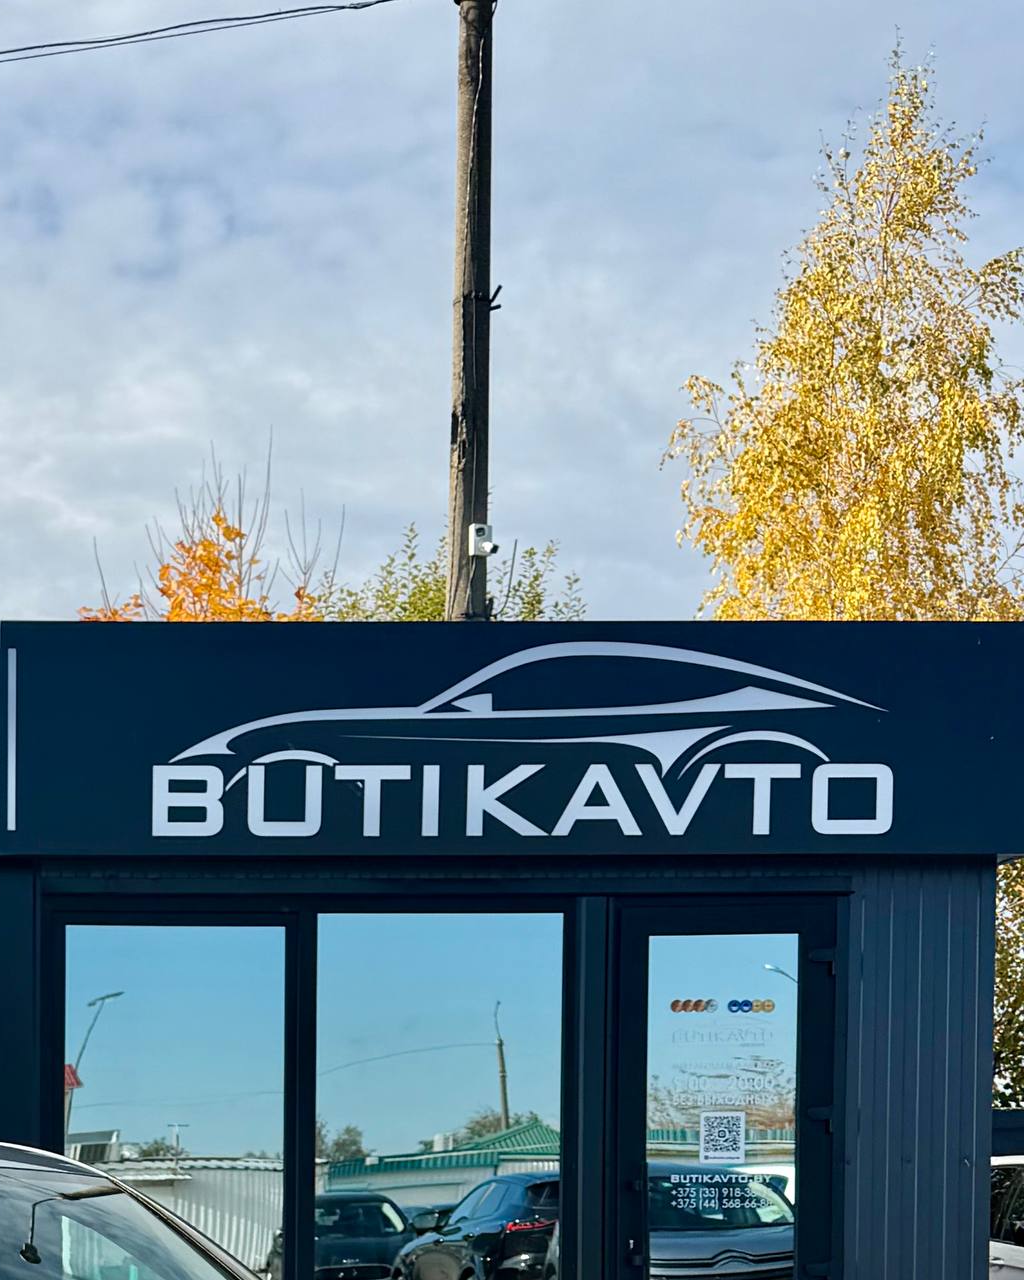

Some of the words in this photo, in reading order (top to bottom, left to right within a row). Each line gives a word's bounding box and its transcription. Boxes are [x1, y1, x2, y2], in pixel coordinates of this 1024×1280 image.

[151, 762, 894, 837] BUTIKAVTO
[670, 1174, 771, 1183] BUTIKAVTO.BY
[670, 1187, 697, 1198] +375
[699, 1187, 719, 1199] (33)
[670, 1198, 697, 1209] +375
[699, 1198, 719, 1210] (44)
